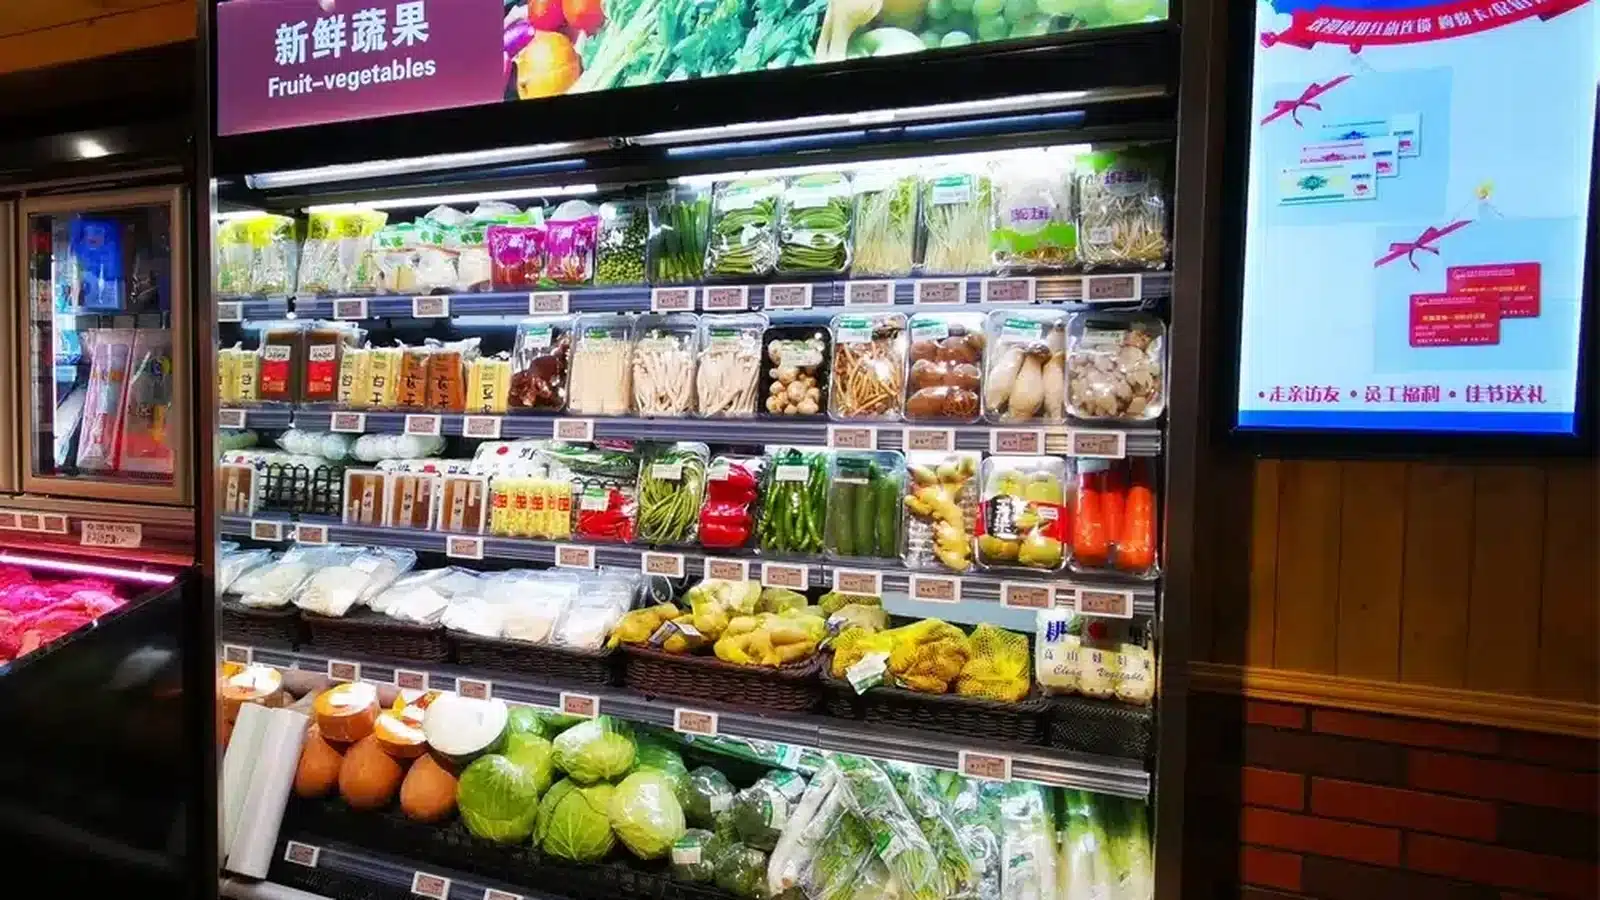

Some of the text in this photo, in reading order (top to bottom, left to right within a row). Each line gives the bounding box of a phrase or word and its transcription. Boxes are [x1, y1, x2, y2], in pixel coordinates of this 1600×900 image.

[273, 0, 430, 67] 新鲜蔬果
[267, 57, 437, 99] Fruit-vegetables
